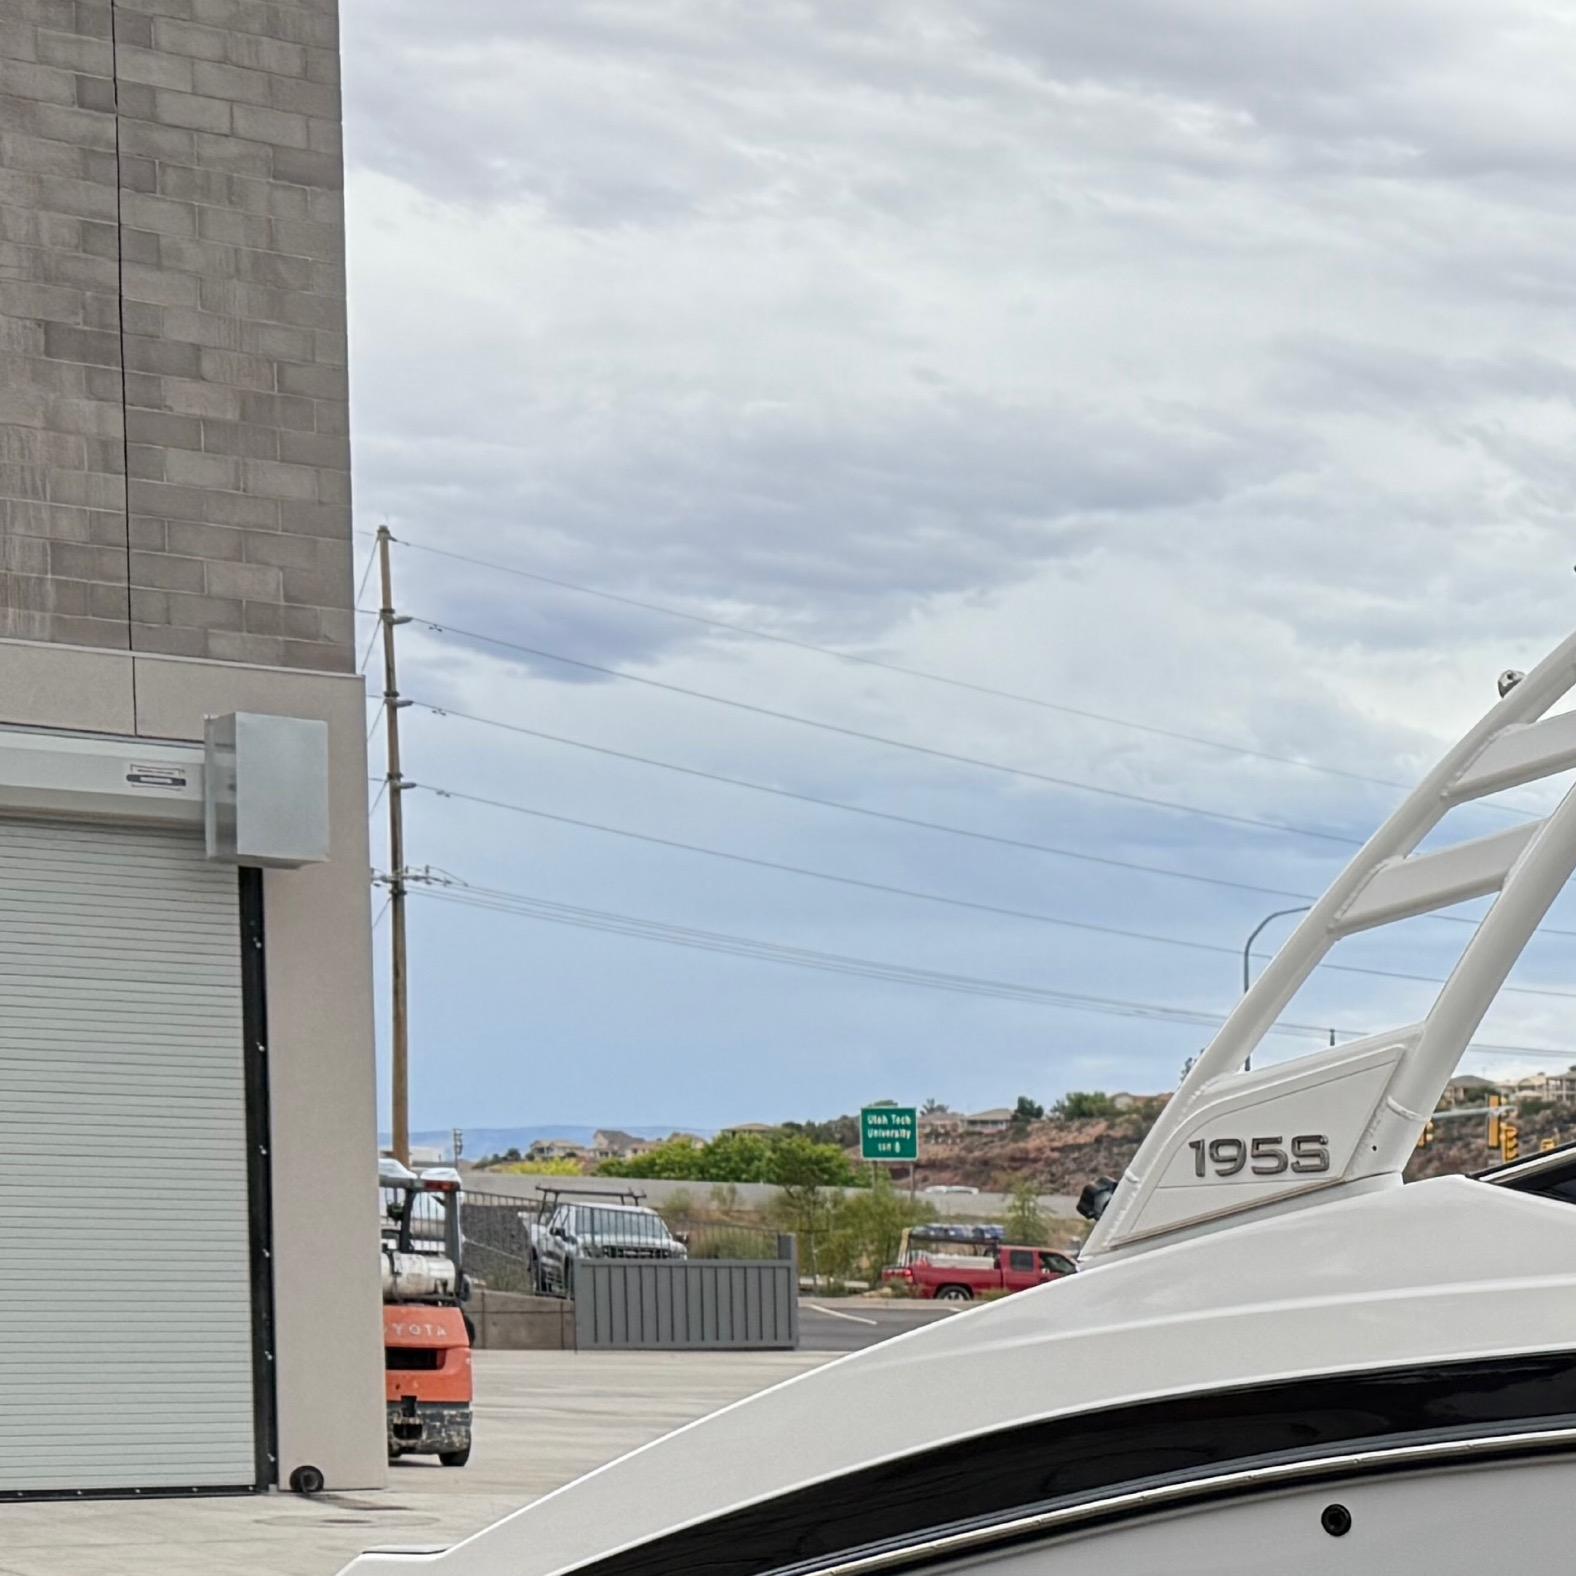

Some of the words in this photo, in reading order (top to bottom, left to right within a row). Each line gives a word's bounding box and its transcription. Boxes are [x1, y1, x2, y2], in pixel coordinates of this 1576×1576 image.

[867, 1114, 888, 1125] Utah
[891, 1114, 911, 1125] Tech
[867, 1128, 911, 1140] University
[1188, 1134, 1330, 1178] 195S
[384, 1323, 447, 1336] YOTA
